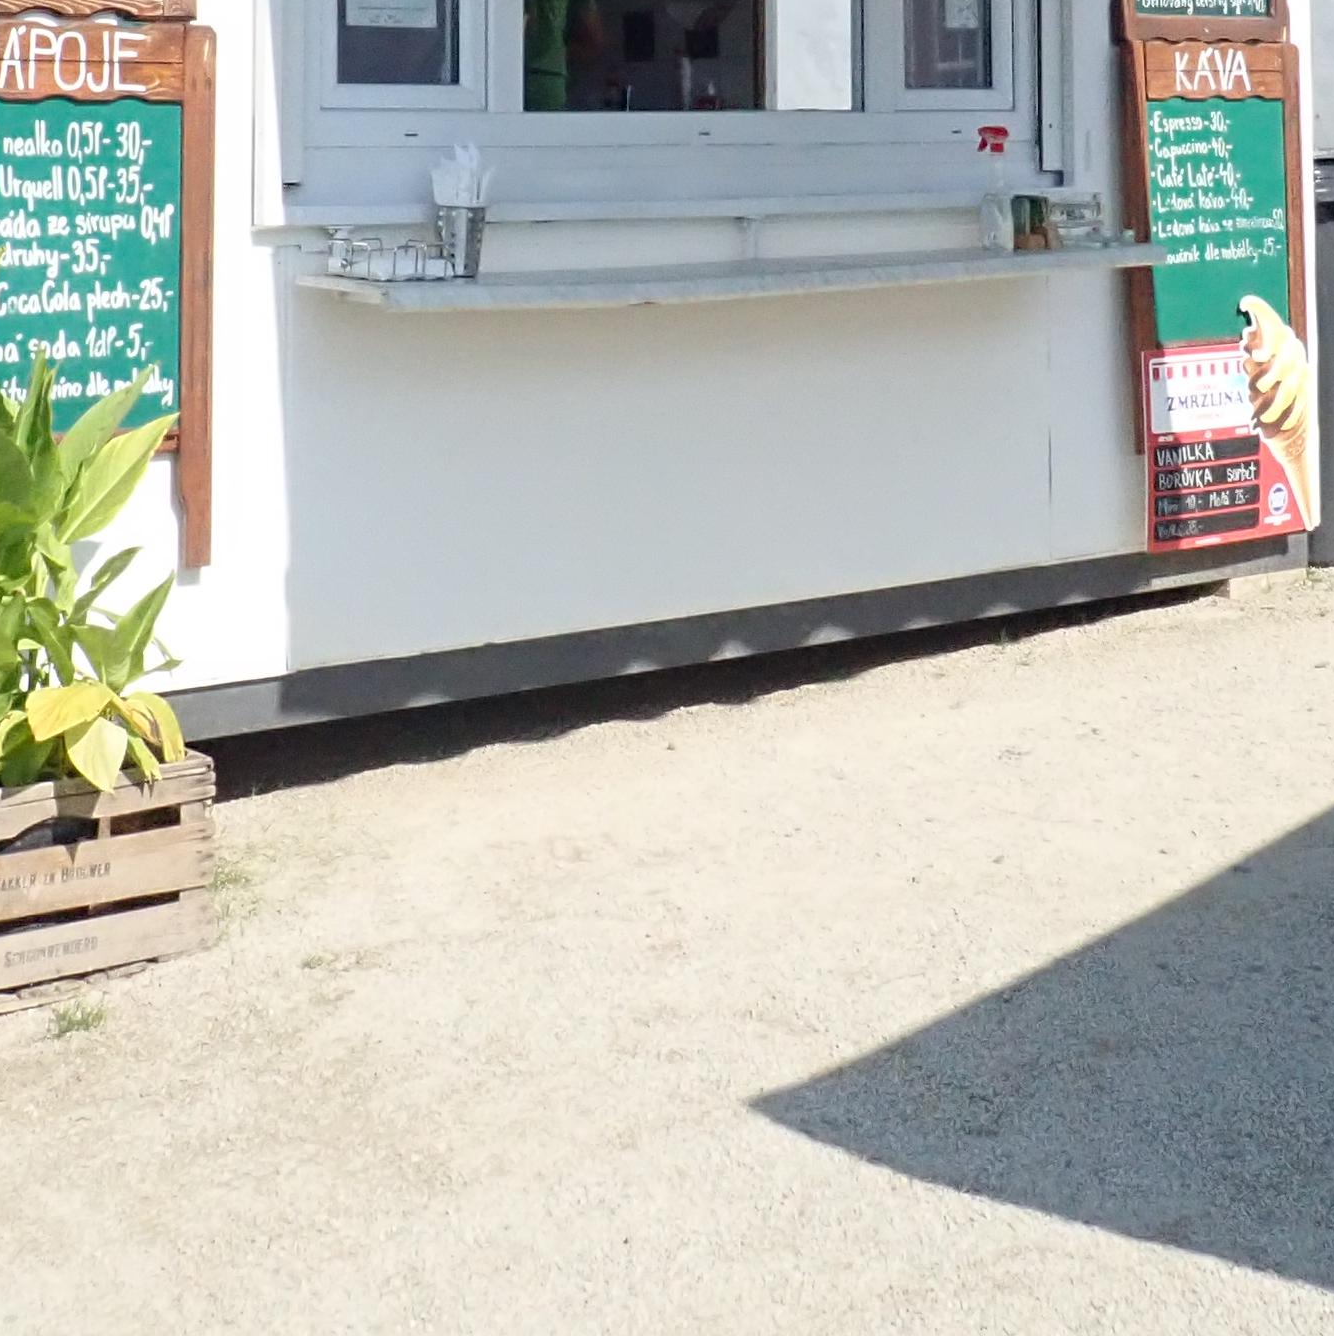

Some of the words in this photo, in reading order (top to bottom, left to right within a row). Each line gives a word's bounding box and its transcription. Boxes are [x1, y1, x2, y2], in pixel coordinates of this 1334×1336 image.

[1174, 47, 1252, 92] KÁVA
[3, 119, 63, 156] nealko
[47, 215, 69, 235] ze
[75, 212, 136, 240] sirupu
[86, 372, 110, 397] dle
[1167, 391, 1244, 412] ZMRZLINA
[1157, 441, 1215, 467] VANILKA
